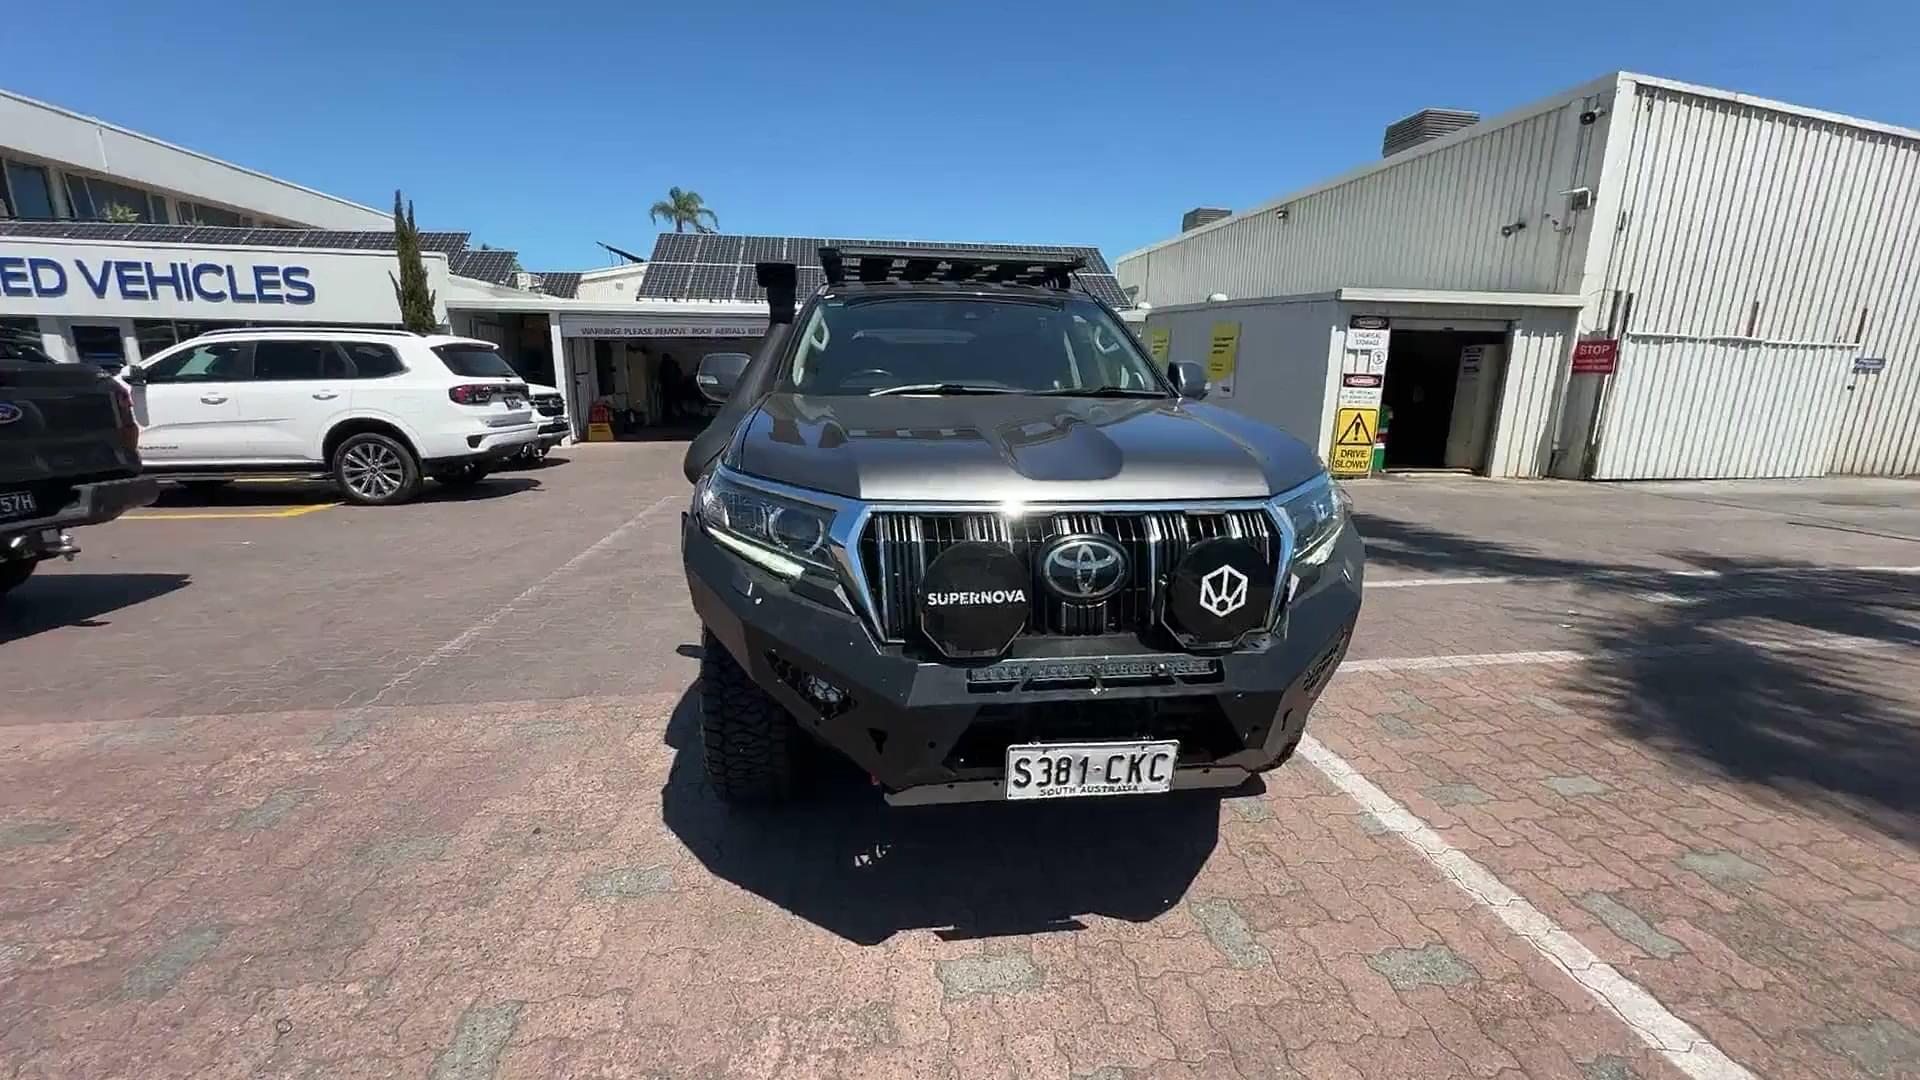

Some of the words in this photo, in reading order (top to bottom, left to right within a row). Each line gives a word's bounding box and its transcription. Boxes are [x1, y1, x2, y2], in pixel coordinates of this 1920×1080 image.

[74, 259, 316, 305] VEHICLES
[624, 327, 654, 335] PLEASE
[655, 327, 687, 335] REMOVE
[692, 327, 712, 335] ROOF
[1580, 345, 1610, 355] STOP
[1340, 449, 1368, 458] DRIVE
[1335, 459, 1369, 469] SLOWLY
[928, 589, 1026, 606] SUPERNOVA
[1040, 787, 1075, 797] SOUTH
[1079, 784, 1139, 794] AUSTRALIA
